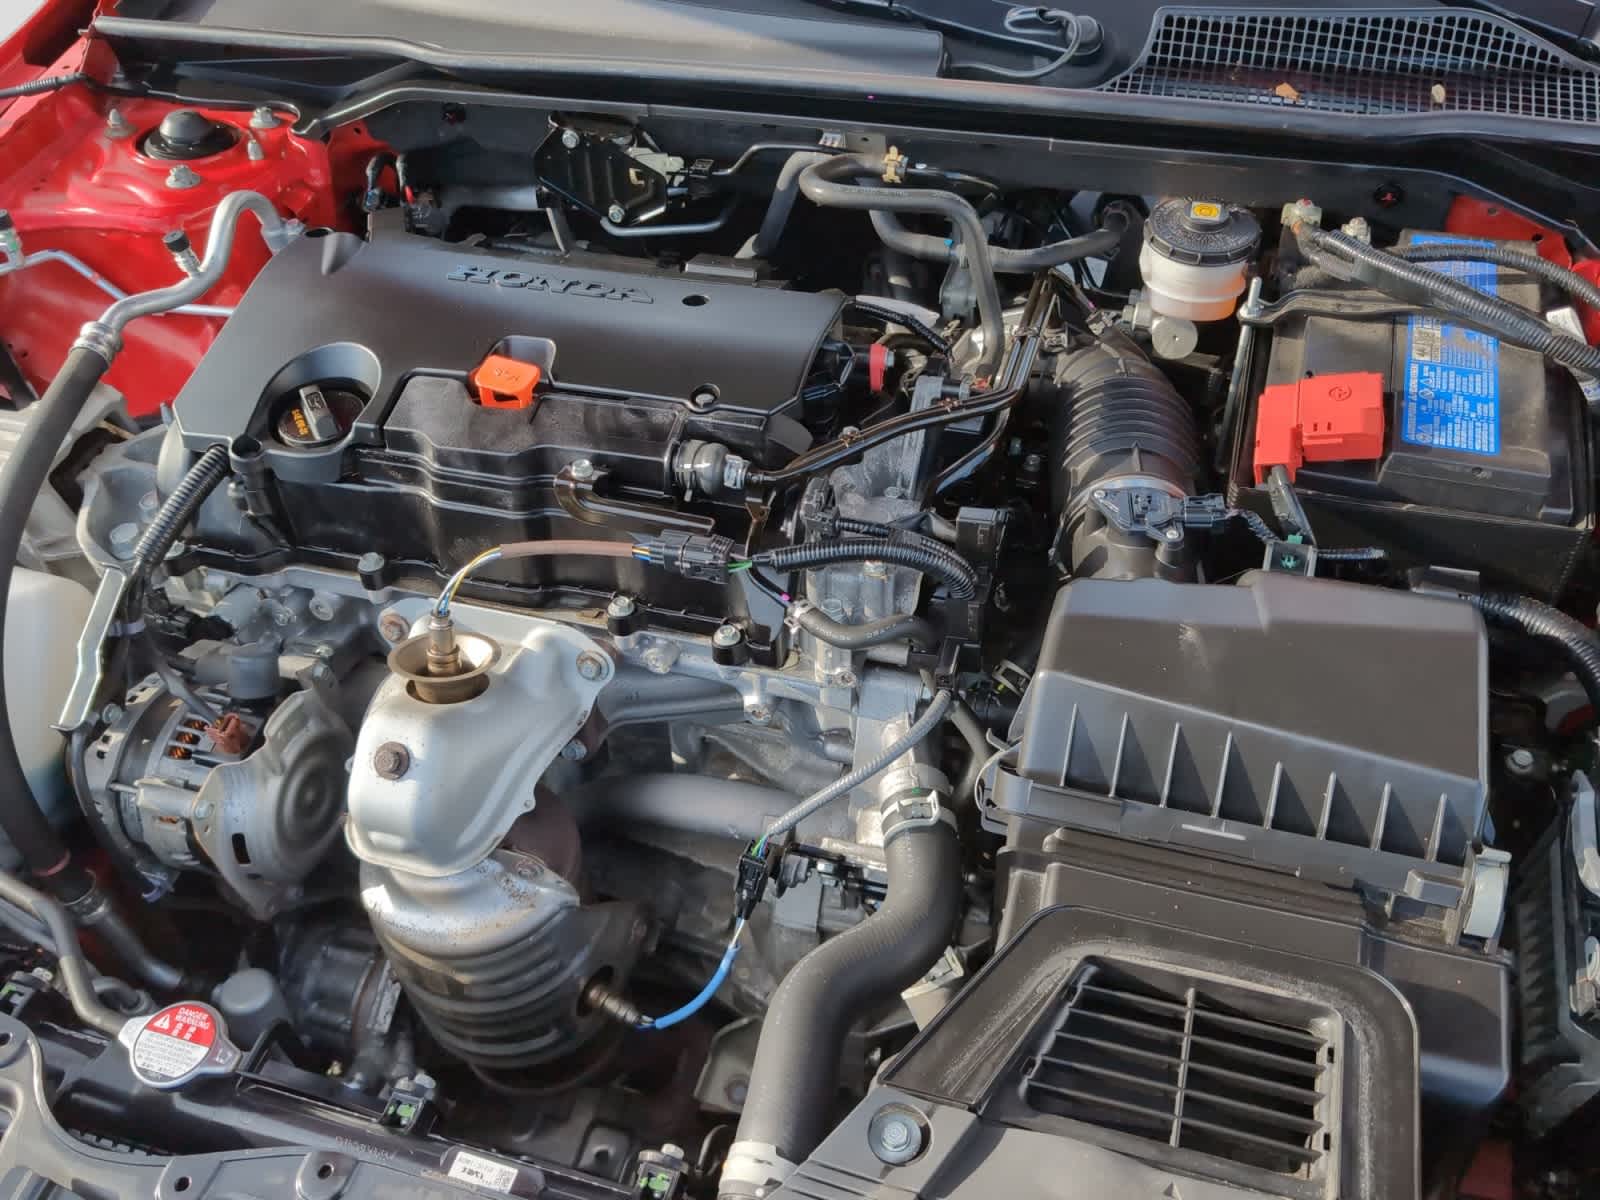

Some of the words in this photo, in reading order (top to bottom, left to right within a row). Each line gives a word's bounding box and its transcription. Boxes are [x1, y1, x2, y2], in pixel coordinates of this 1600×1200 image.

[447, 263, 654, 304] HONDA
[178, 1006, 209, 1021] DANGER
[175, 1014, 211, 1030] WARNING
